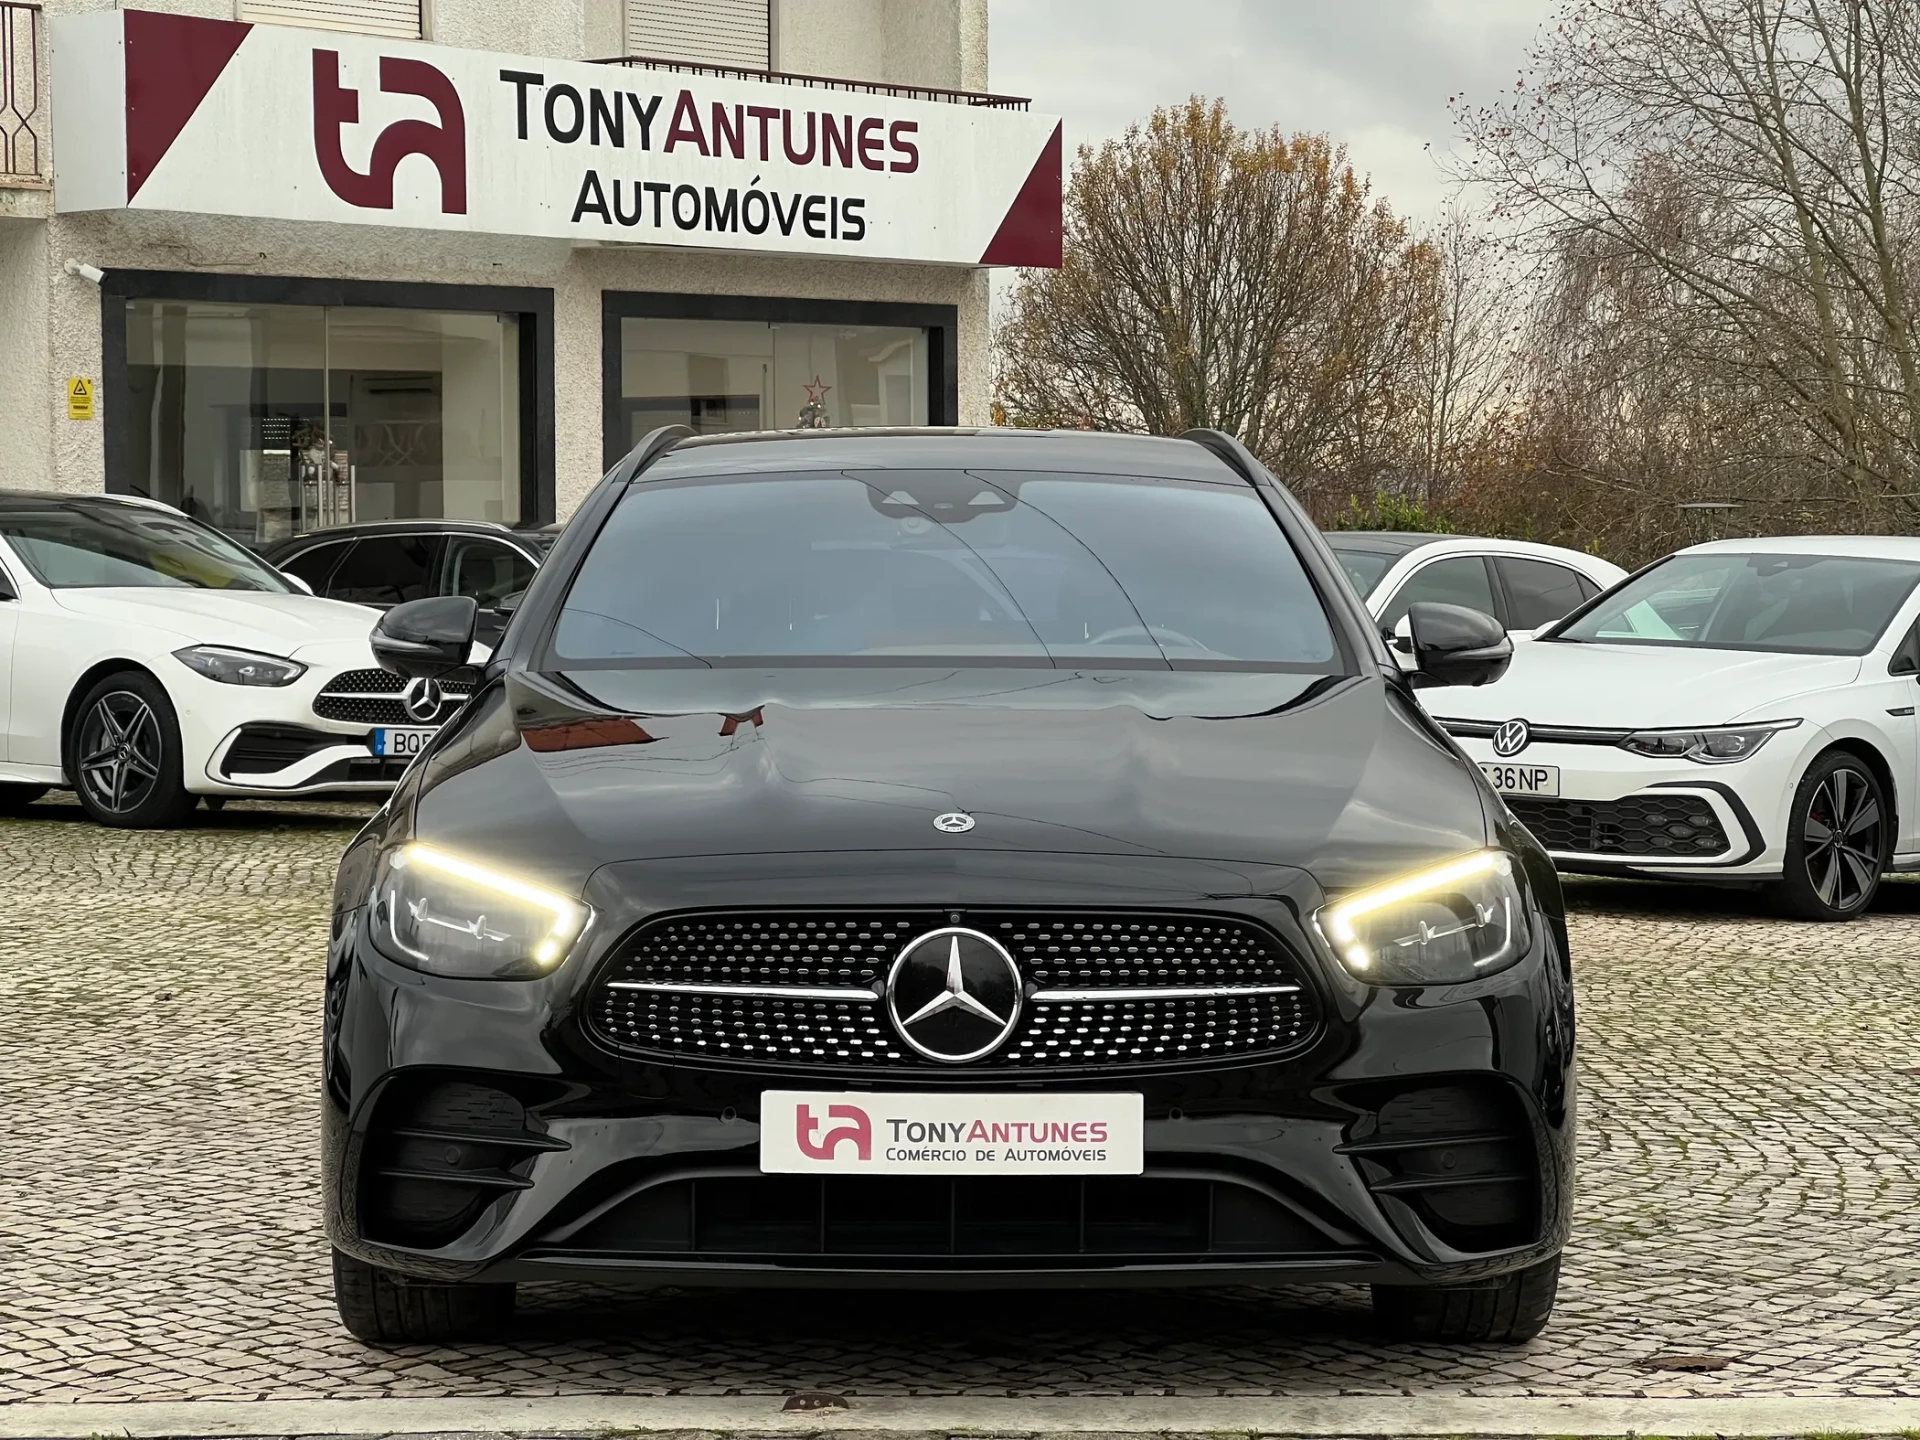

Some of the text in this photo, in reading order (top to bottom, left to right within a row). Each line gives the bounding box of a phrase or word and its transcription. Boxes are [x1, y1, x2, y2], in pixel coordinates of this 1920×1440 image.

[571, 169, 866, 241] AUTOMÓVEIS
[886, 1146, 1107, 1162] COMÉRCIO DE AUTOMÓVEIS
